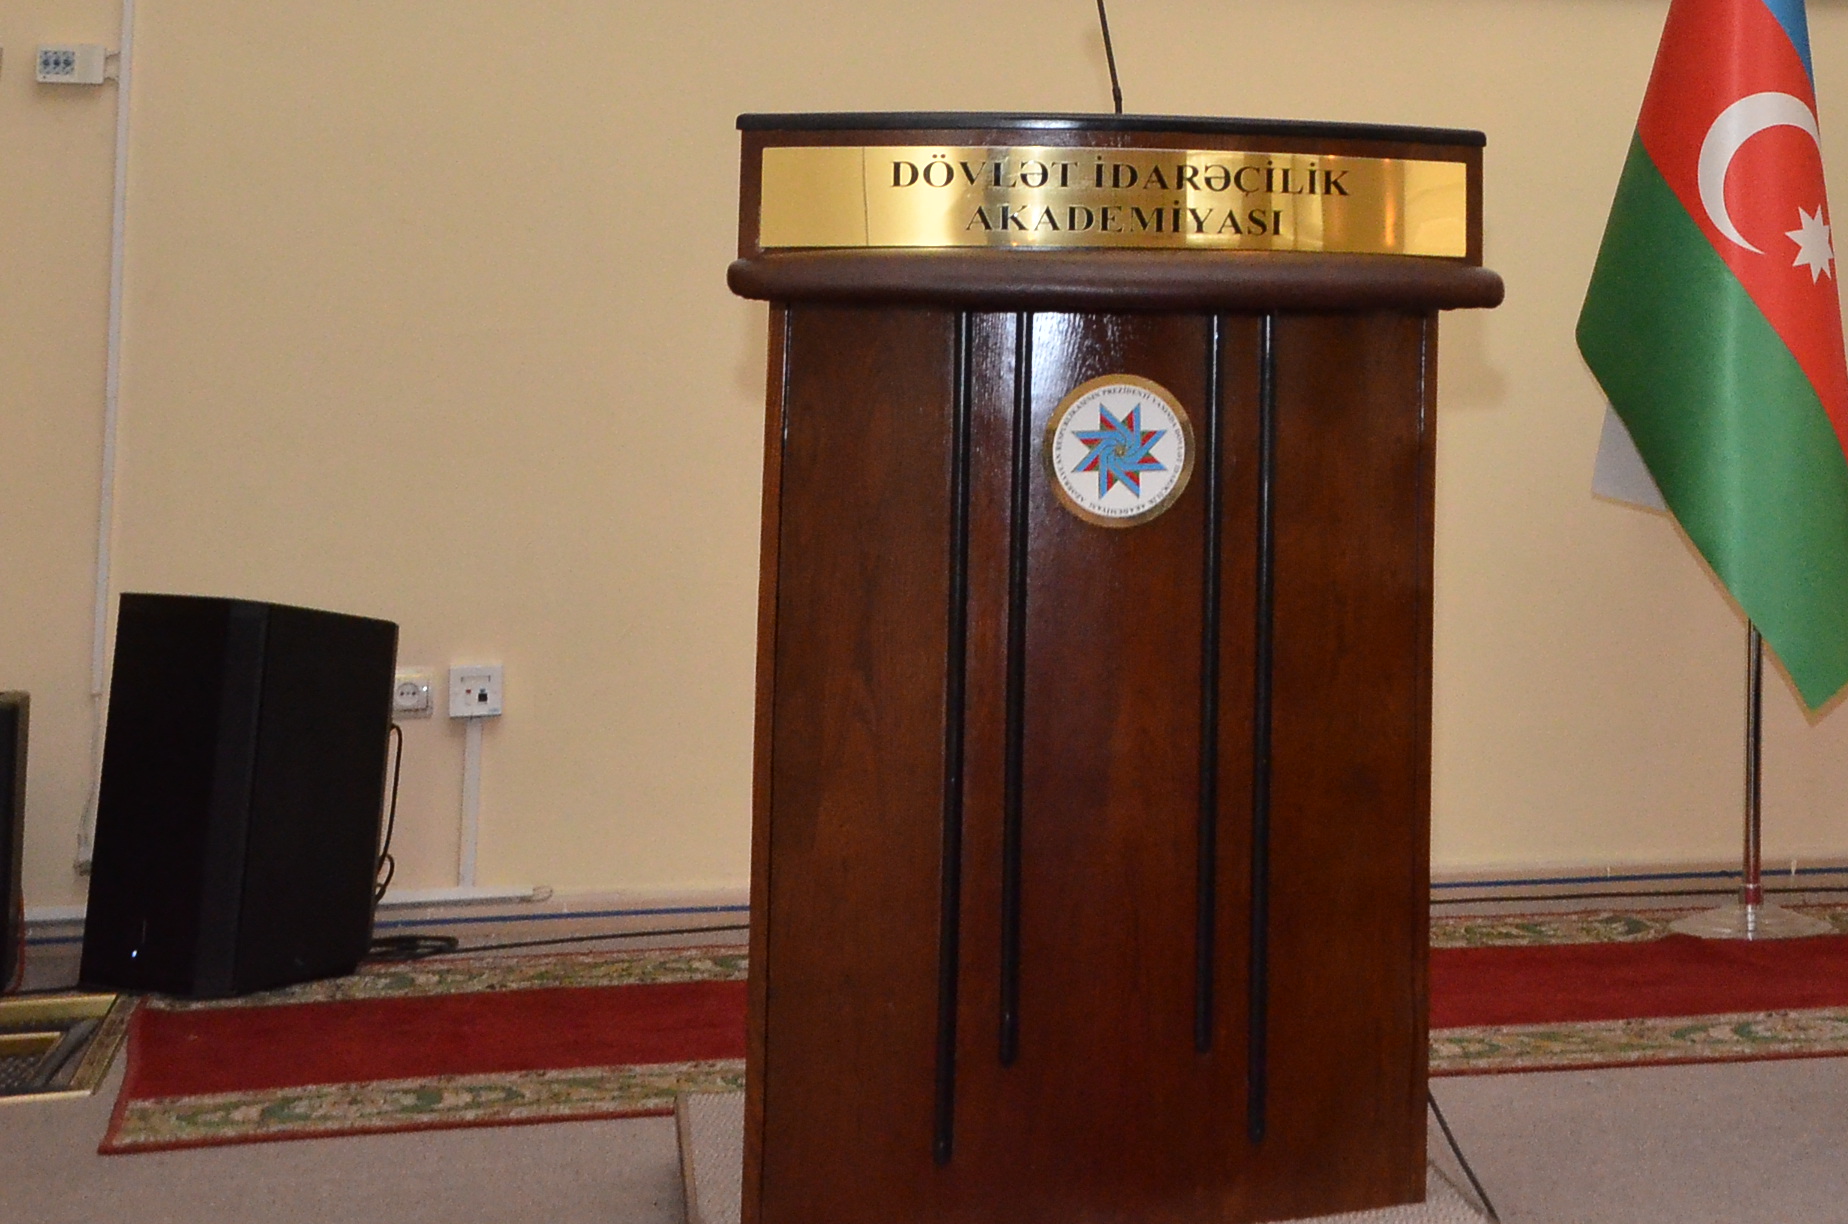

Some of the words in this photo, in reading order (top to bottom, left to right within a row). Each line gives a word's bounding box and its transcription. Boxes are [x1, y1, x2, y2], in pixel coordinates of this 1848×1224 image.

[890, 155, 1079, 190] DÖVLƏT
[1094, 154, 1350, 197] İDARƏÇİLİK
[965, 199, 1283, 236] AKADEMİYASI
